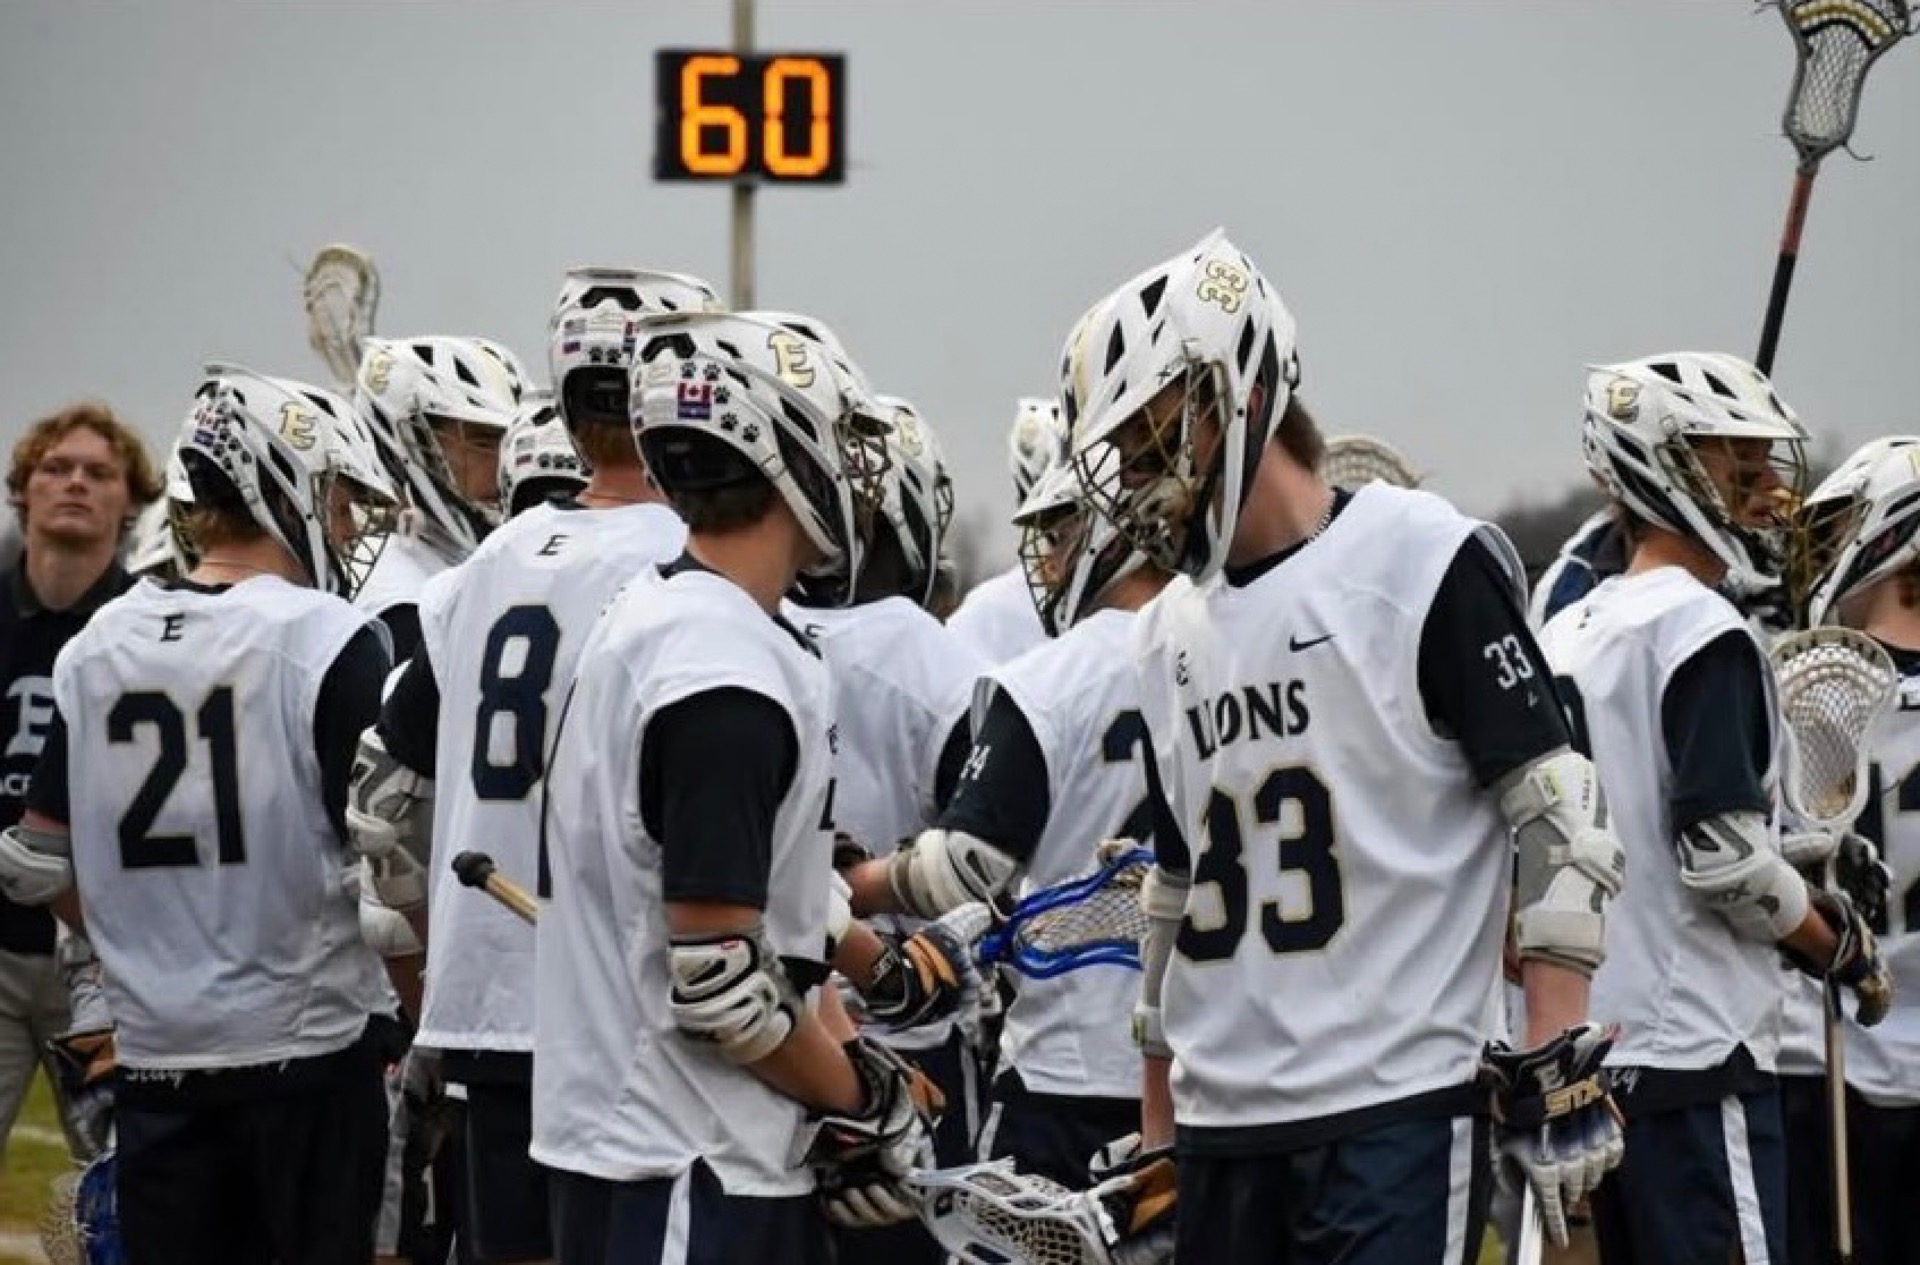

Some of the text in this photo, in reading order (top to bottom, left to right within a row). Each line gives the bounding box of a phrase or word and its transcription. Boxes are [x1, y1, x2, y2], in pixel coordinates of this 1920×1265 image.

[681, 55, 830, 177] 60
[768, 330, 816, 388] E
[279, 400, 318, 450] E
[538, 533, 569, 556] E
[160, 612, 185, 642] E
[1483, 633, 1534, 690] 33
[470, 603, 561, 800] 8
[104, 684, 247, 870] 21
[1175, 764, 1345, 963] 33
